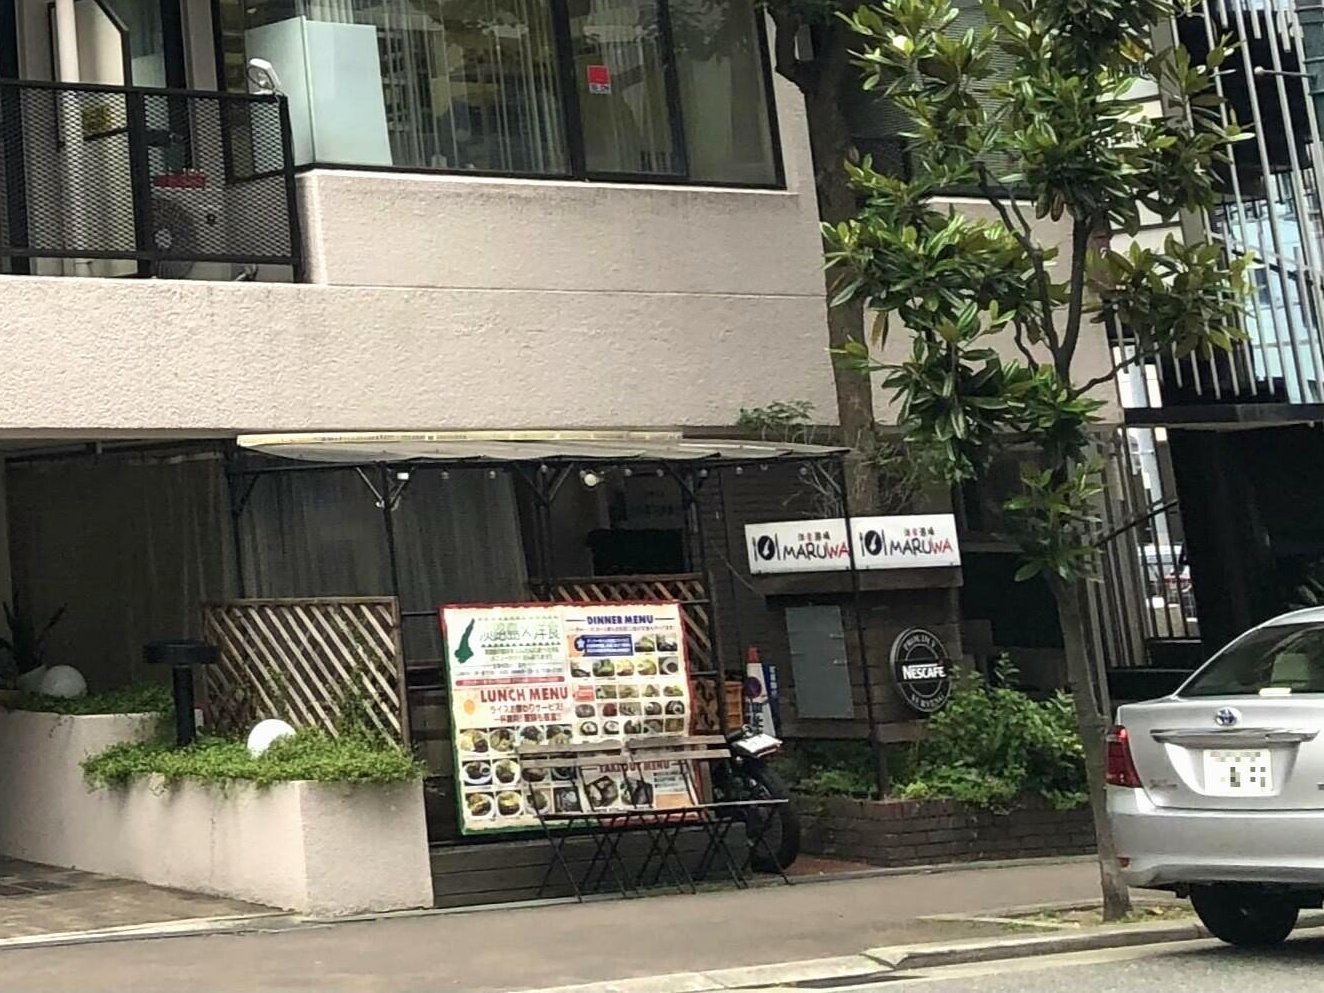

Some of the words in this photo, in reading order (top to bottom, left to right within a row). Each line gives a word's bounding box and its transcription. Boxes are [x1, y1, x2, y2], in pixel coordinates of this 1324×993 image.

[783, 542, 850, 560] MARUWA
[889, 537, 954, 557] MARUWA
[587, 615, 623, 625] DINNER
[625, 614, 654, 624] MENU
[480, 689, 526, 703] LUNCH
[529, 687, 568, 701] MENU
